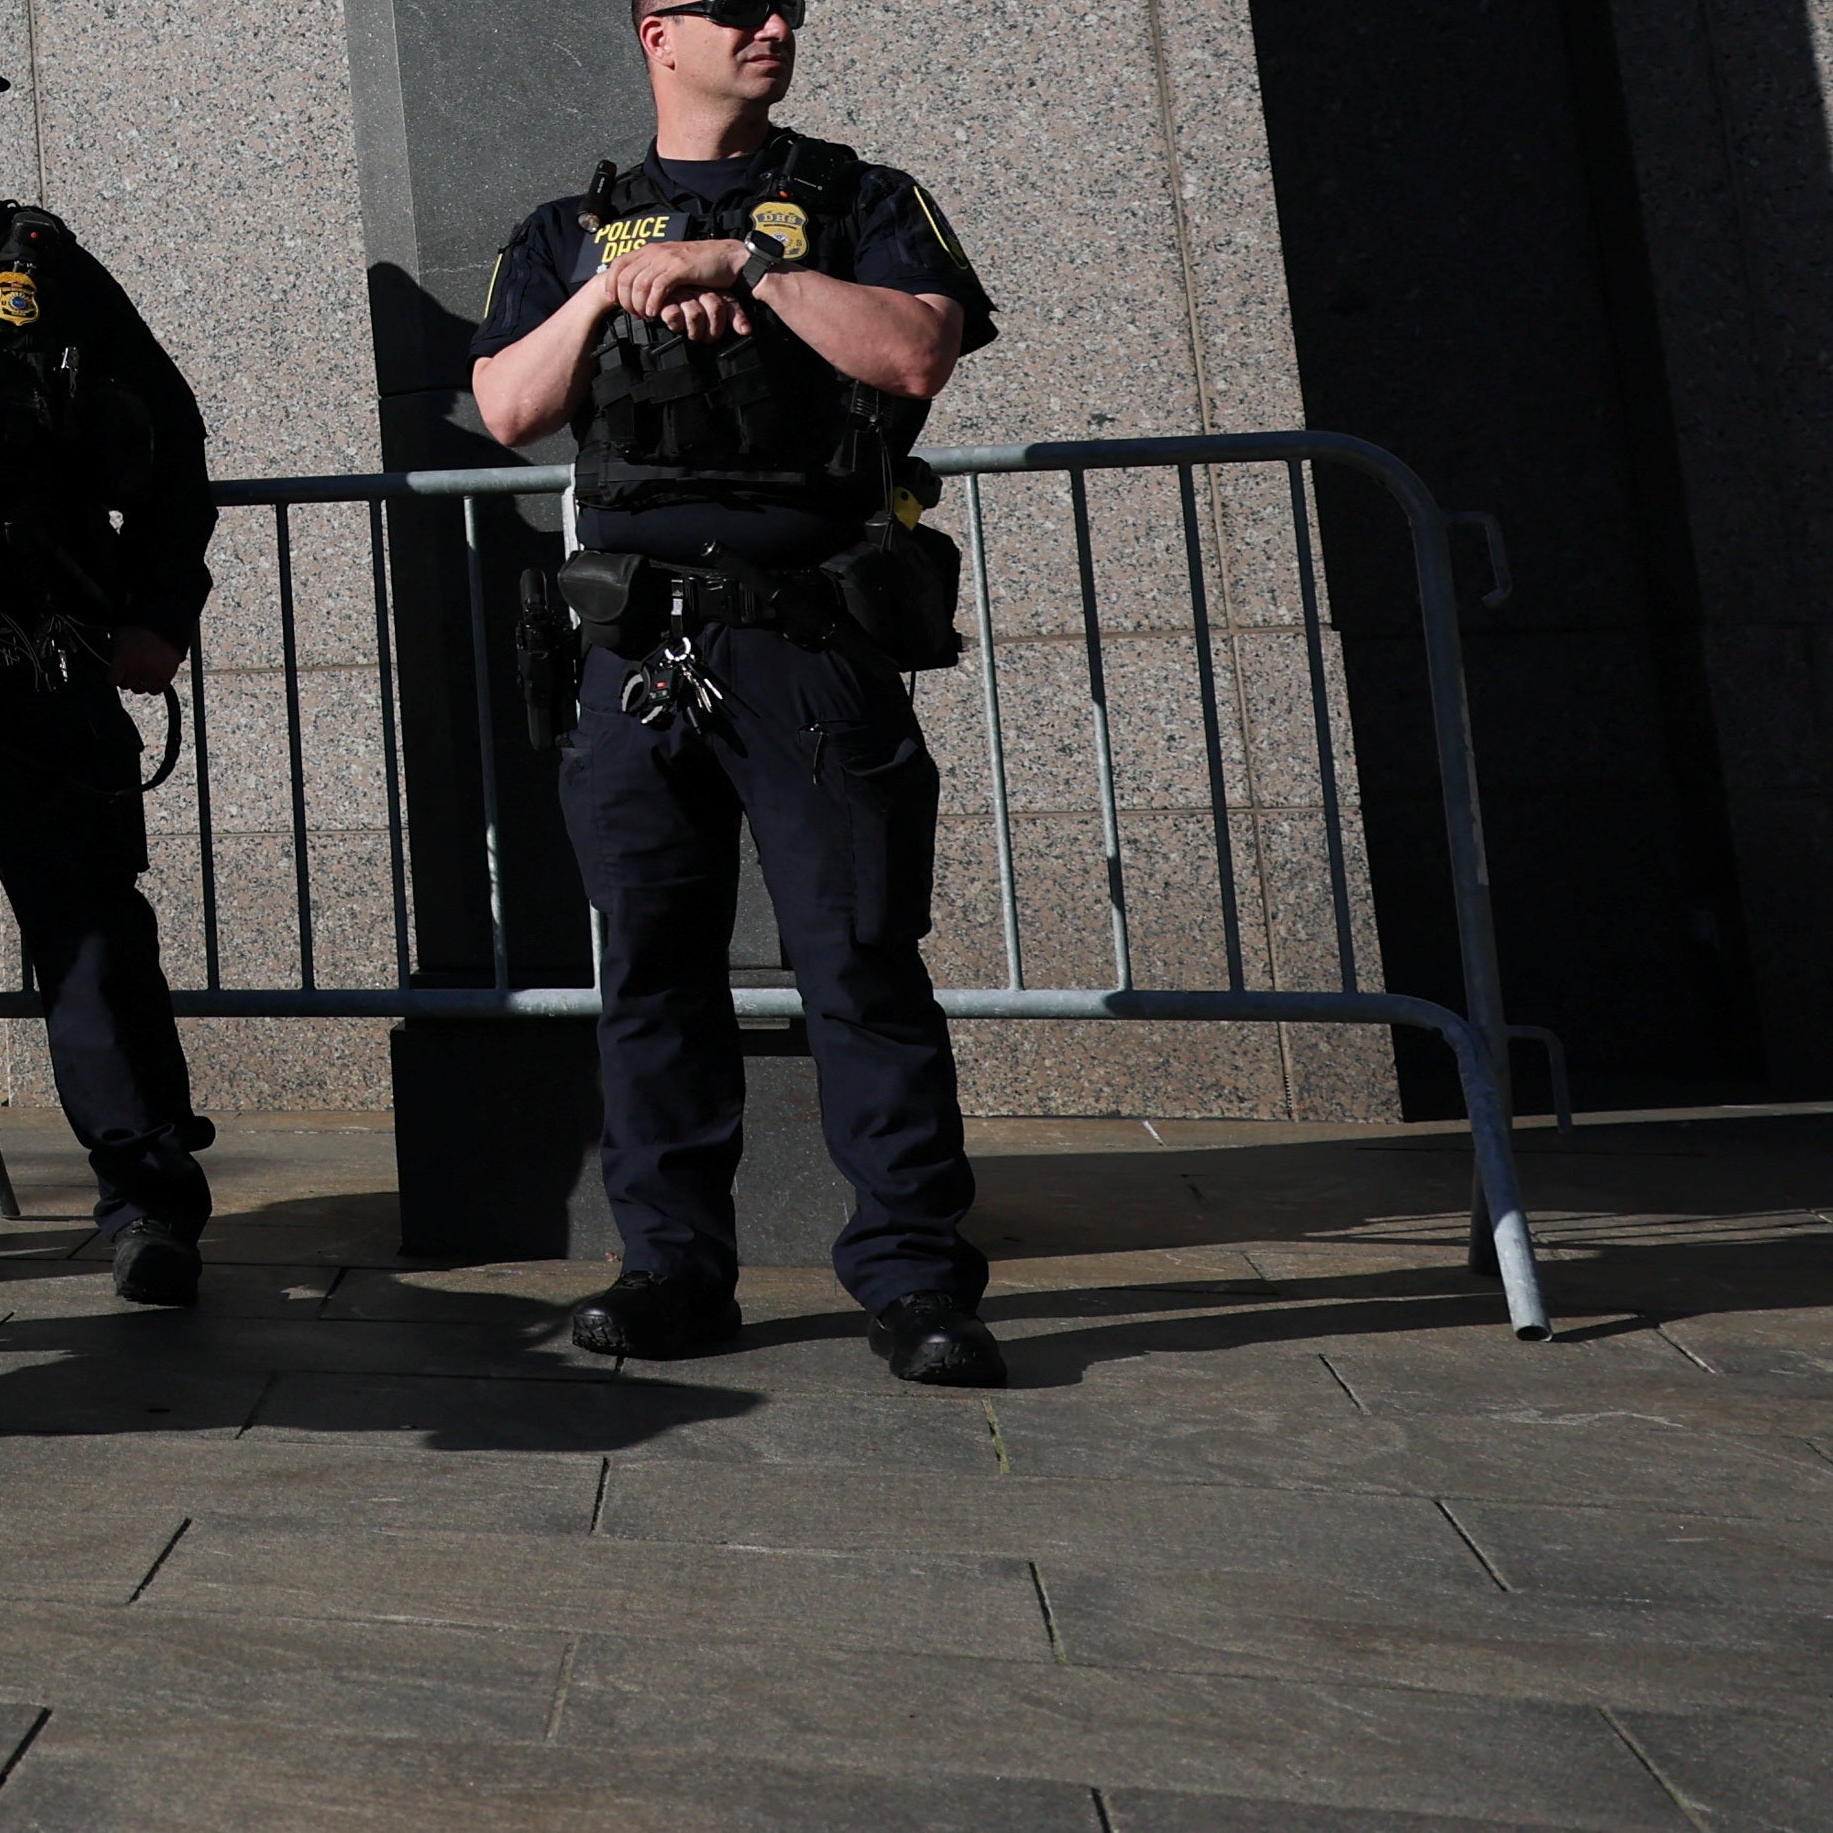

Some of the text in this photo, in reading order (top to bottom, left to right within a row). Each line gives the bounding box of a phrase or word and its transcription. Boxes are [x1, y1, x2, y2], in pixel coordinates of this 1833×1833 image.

[594, 216, 671, 244] POLICE
[763, 213, 797, 224] DHS
[601, 238, 648, 264] DHS
